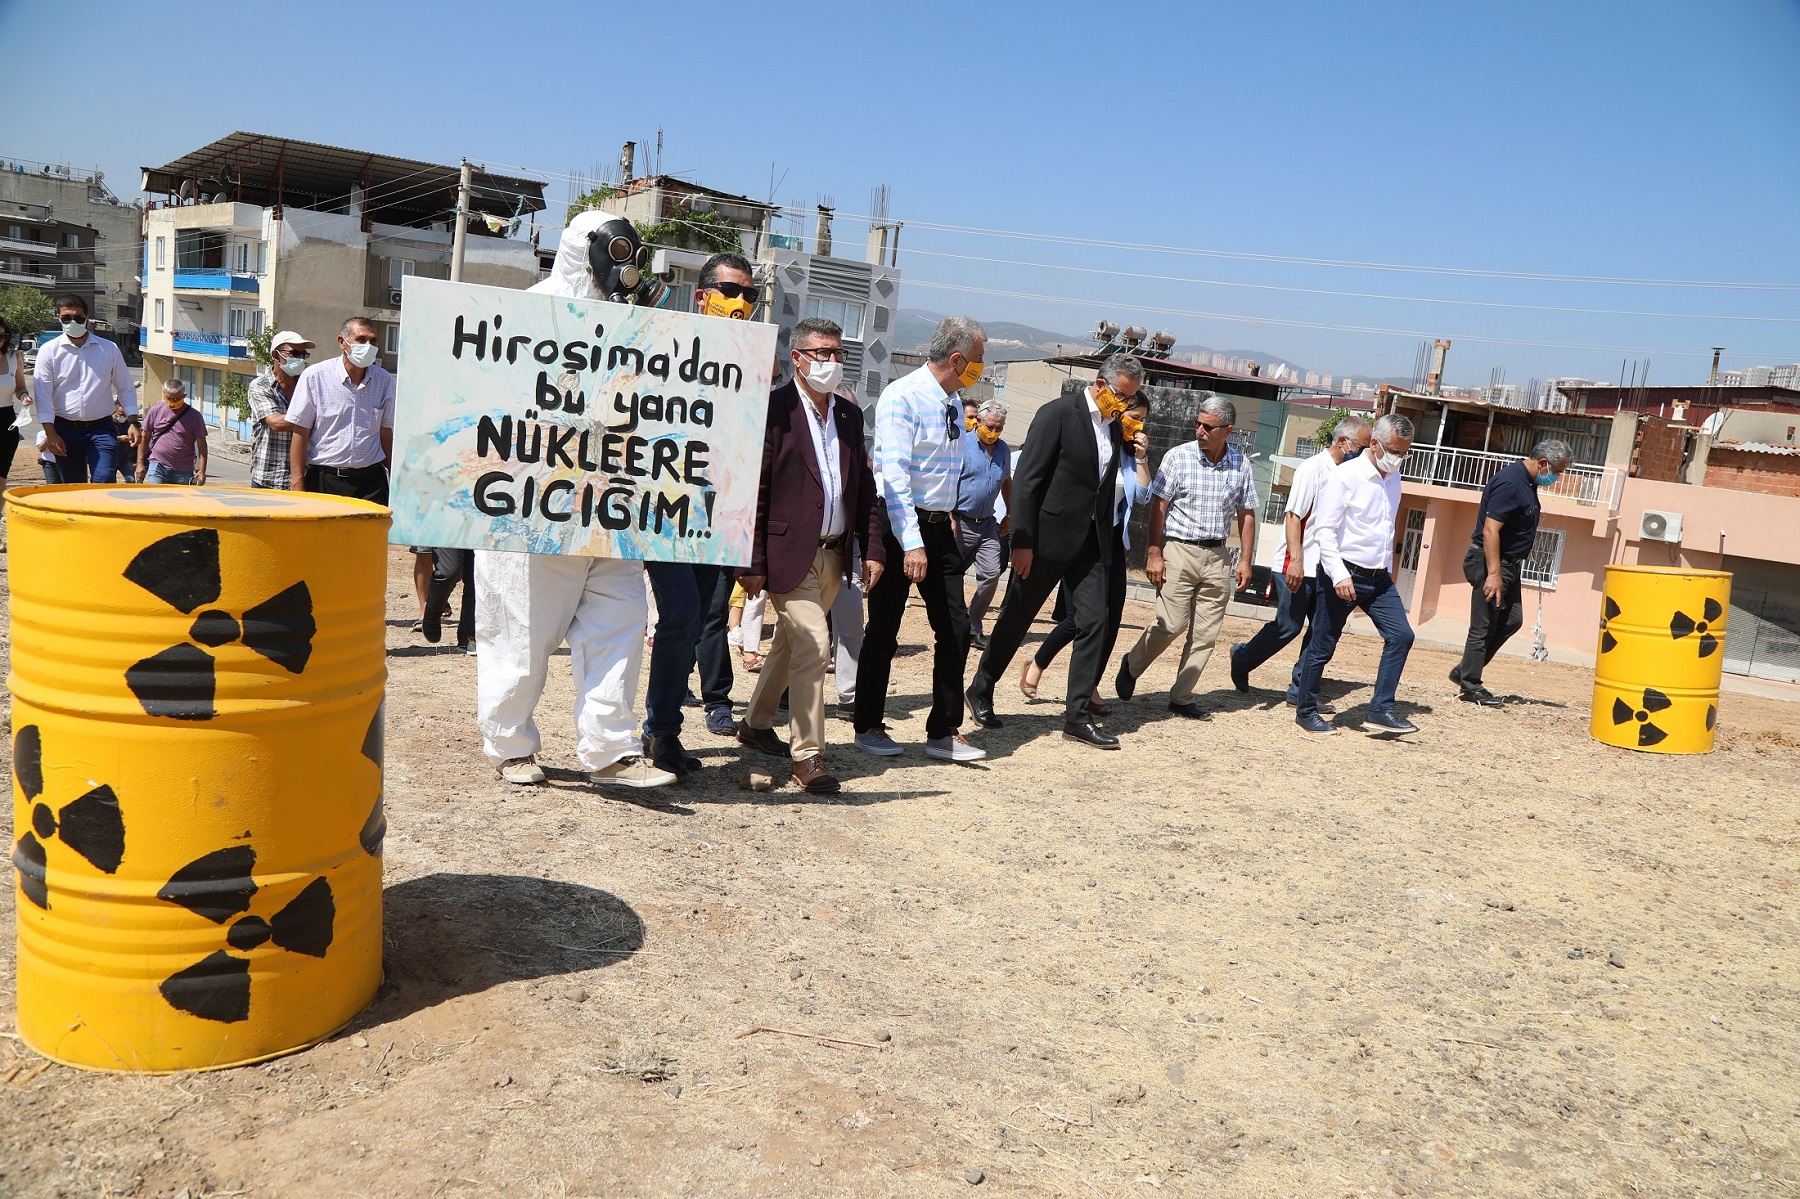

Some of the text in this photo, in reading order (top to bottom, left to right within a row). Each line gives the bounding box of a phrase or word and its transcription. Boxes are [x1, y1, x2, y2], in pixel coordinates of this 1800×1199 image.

[452, 314, 743, 392] Hiroşima'dan
[535, 371, 714, 433] bu yana
[476, 408, 713, 488] NÜKLEERE
